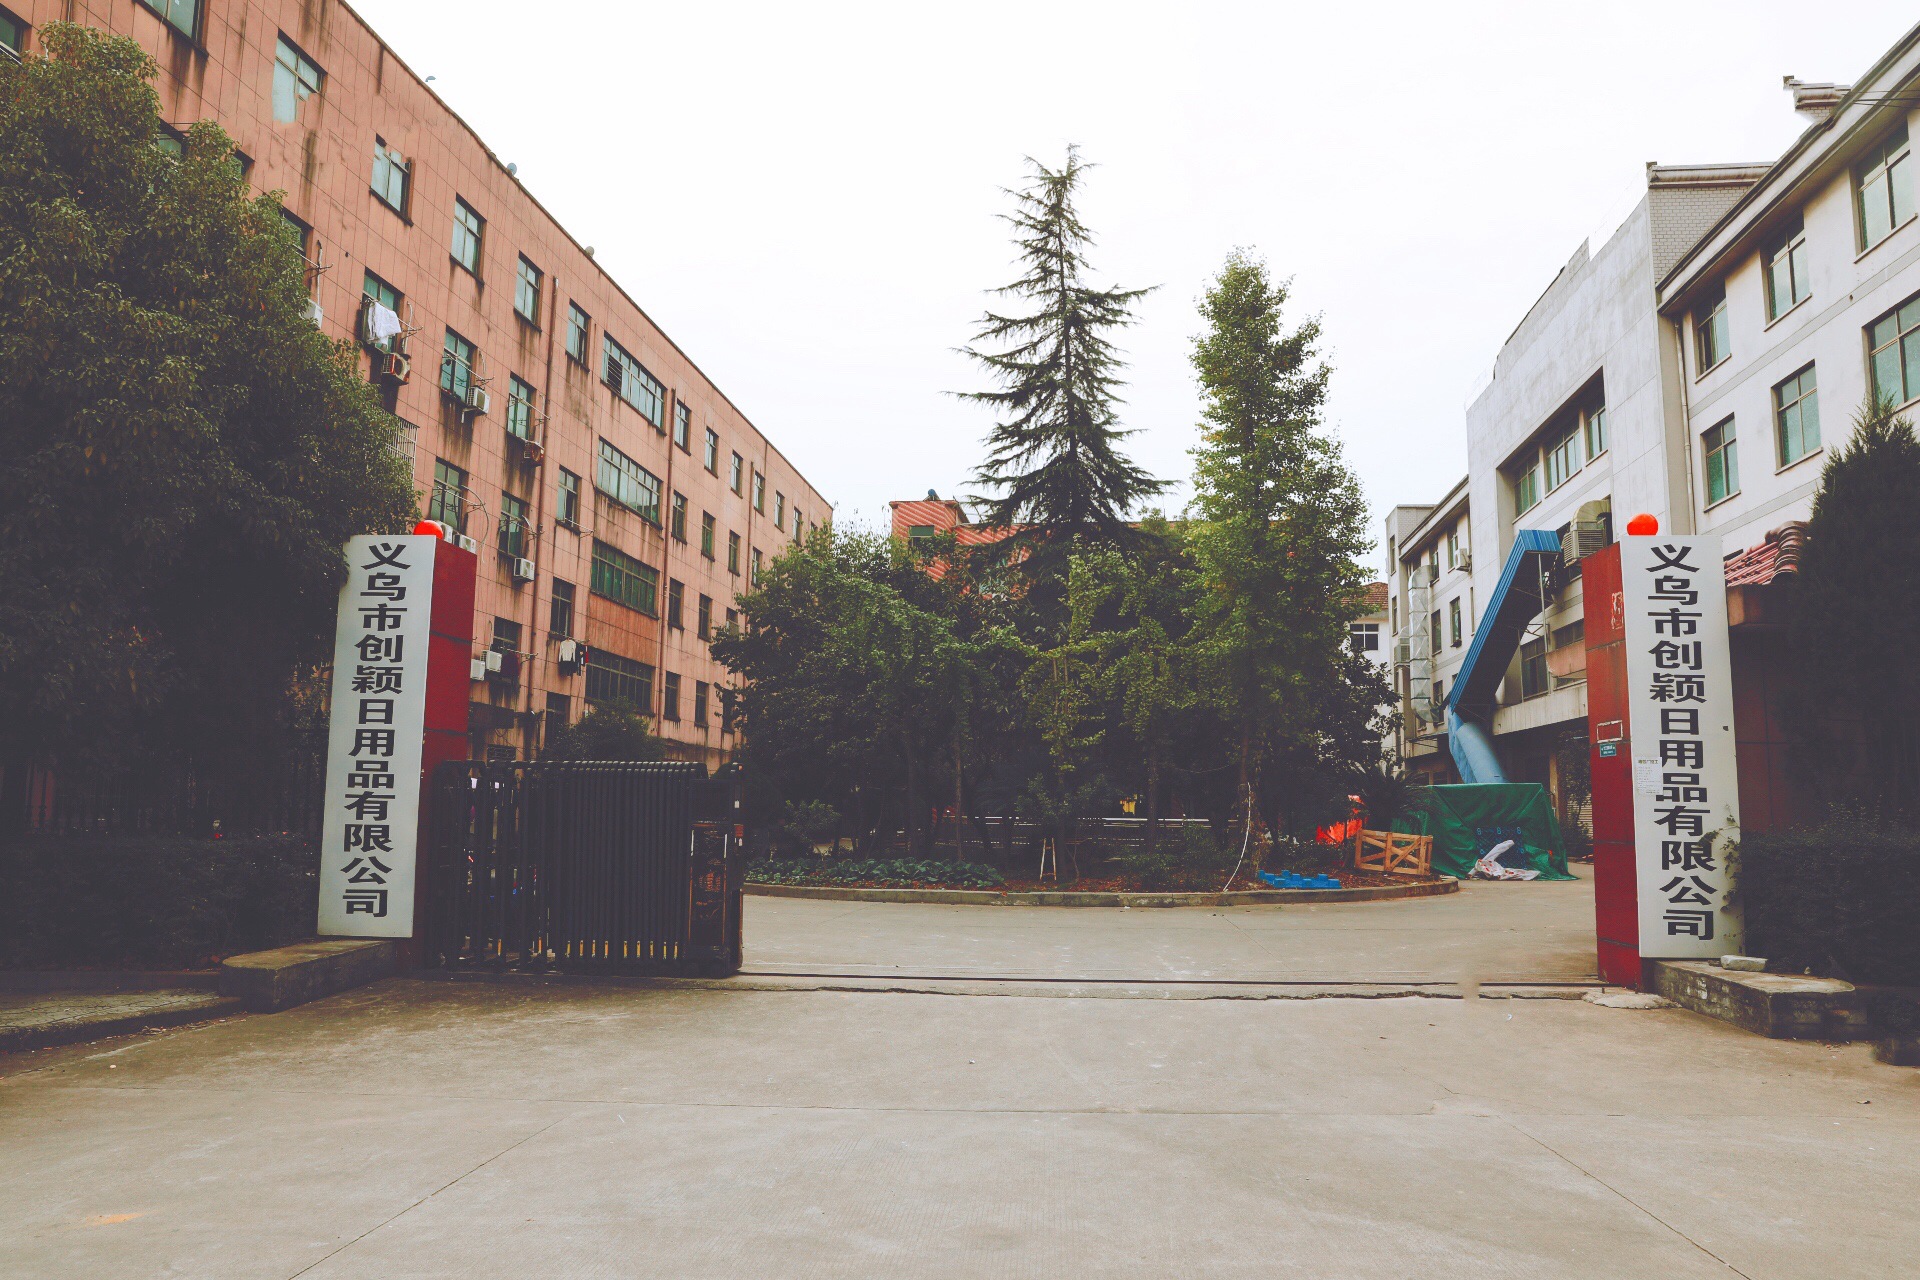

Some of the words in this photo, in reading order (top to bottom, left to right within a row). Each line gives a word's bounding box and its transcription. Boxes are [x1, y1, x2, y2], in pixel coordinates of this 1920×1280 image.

[340, 542, 411, 918] 义乌市创颖日用品有限公司
[1645, 543, 1718, 941] 义乌市创颖日用品有限公司
